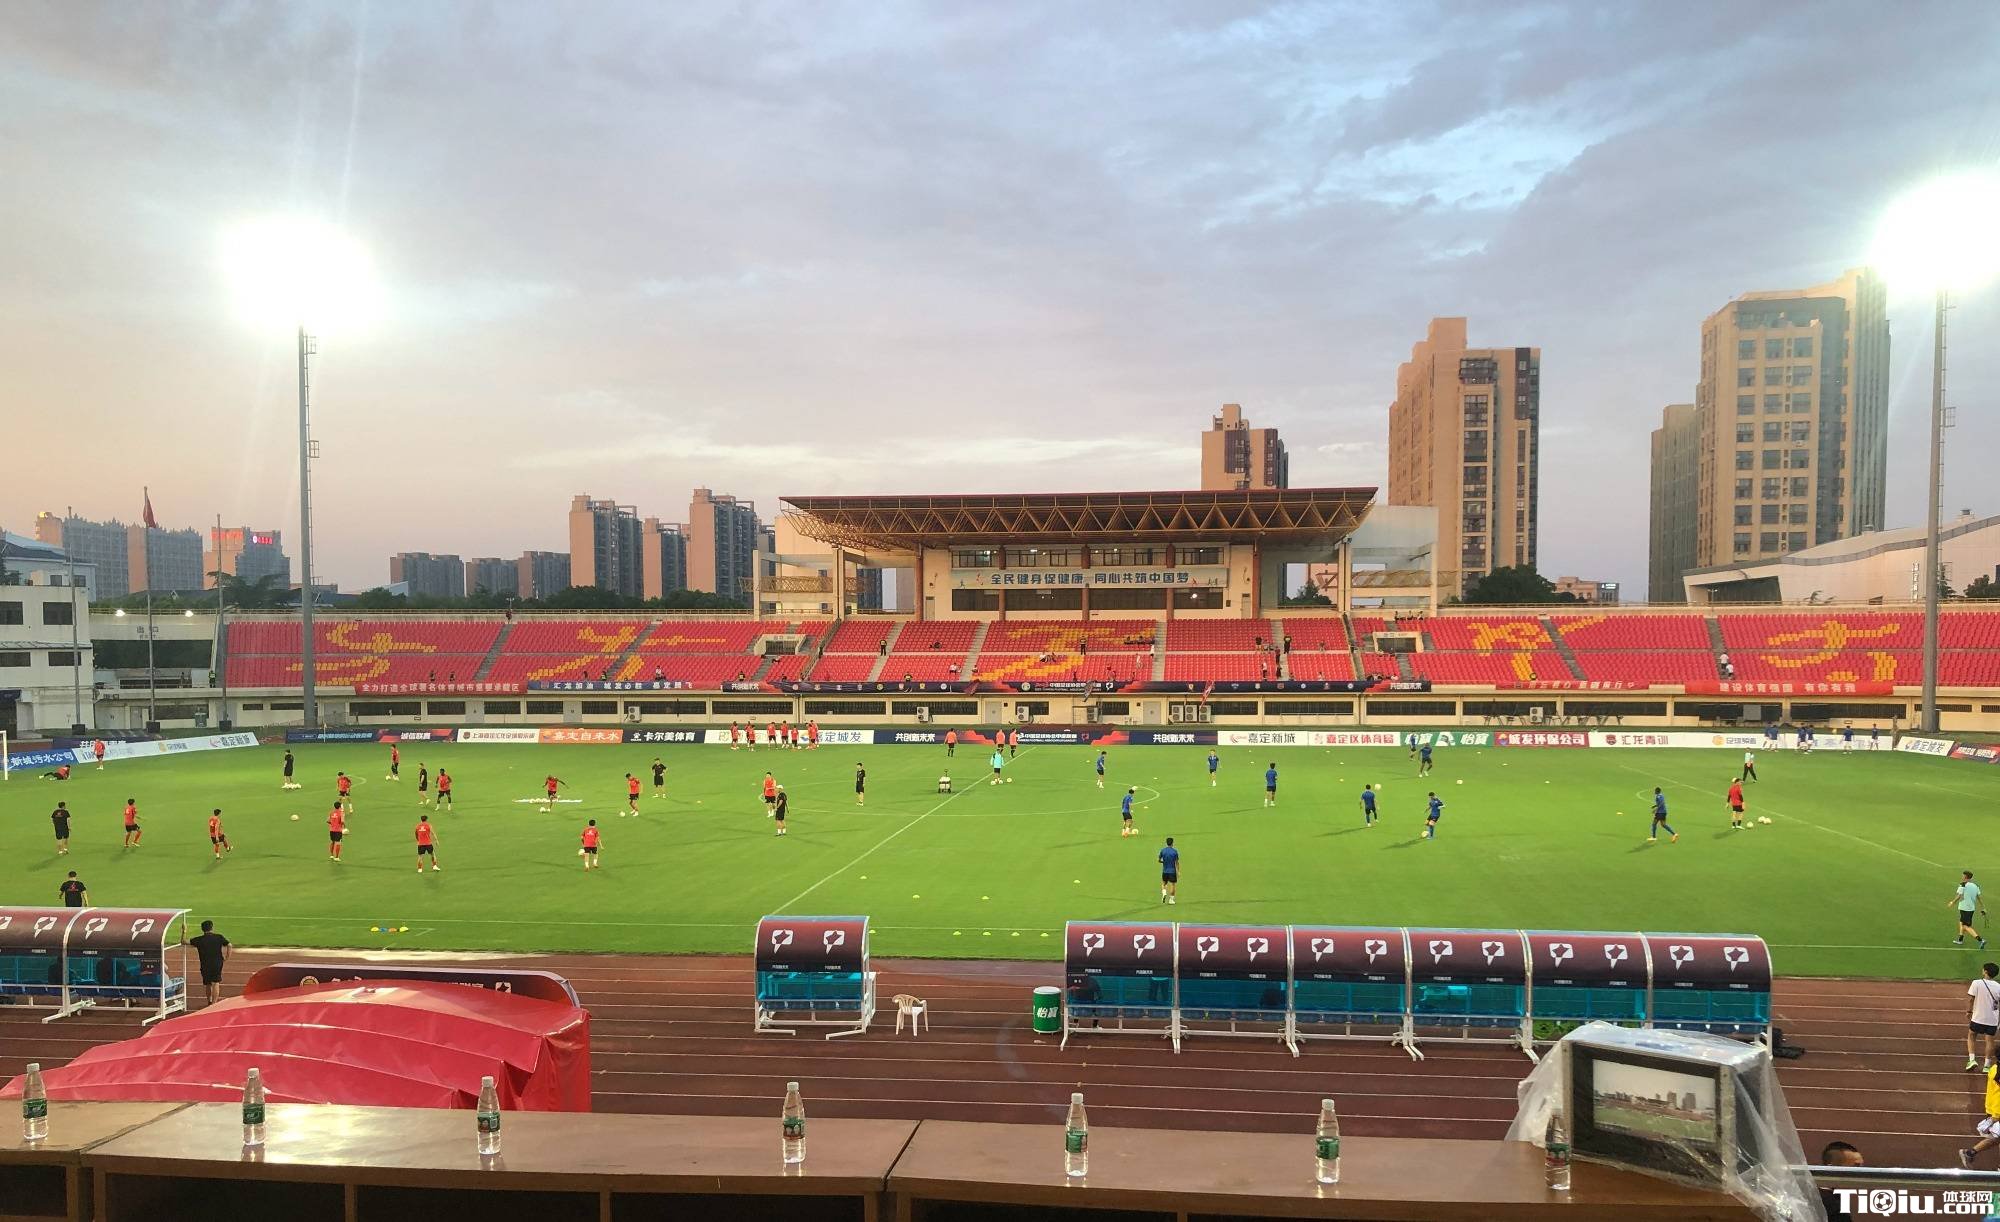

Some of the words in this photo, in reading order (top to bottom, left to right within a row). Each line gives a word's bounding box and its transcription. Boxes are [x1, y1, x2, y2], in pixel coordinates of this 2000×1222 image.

[991, 573, 1083, 585] 全民健身促健康
[1094, 571, 1189, 584] 同心共筑中国梦
[553, 682, 594, 690] 汇龙加油
[1719, 682, 1793, 693] 建设体育强国
[1804, 682, 1856, 694] 有你有我
[643, 732, 696, 742] 卡尔美体育
[1247, 733, 1296, 744] 嘉定新城
